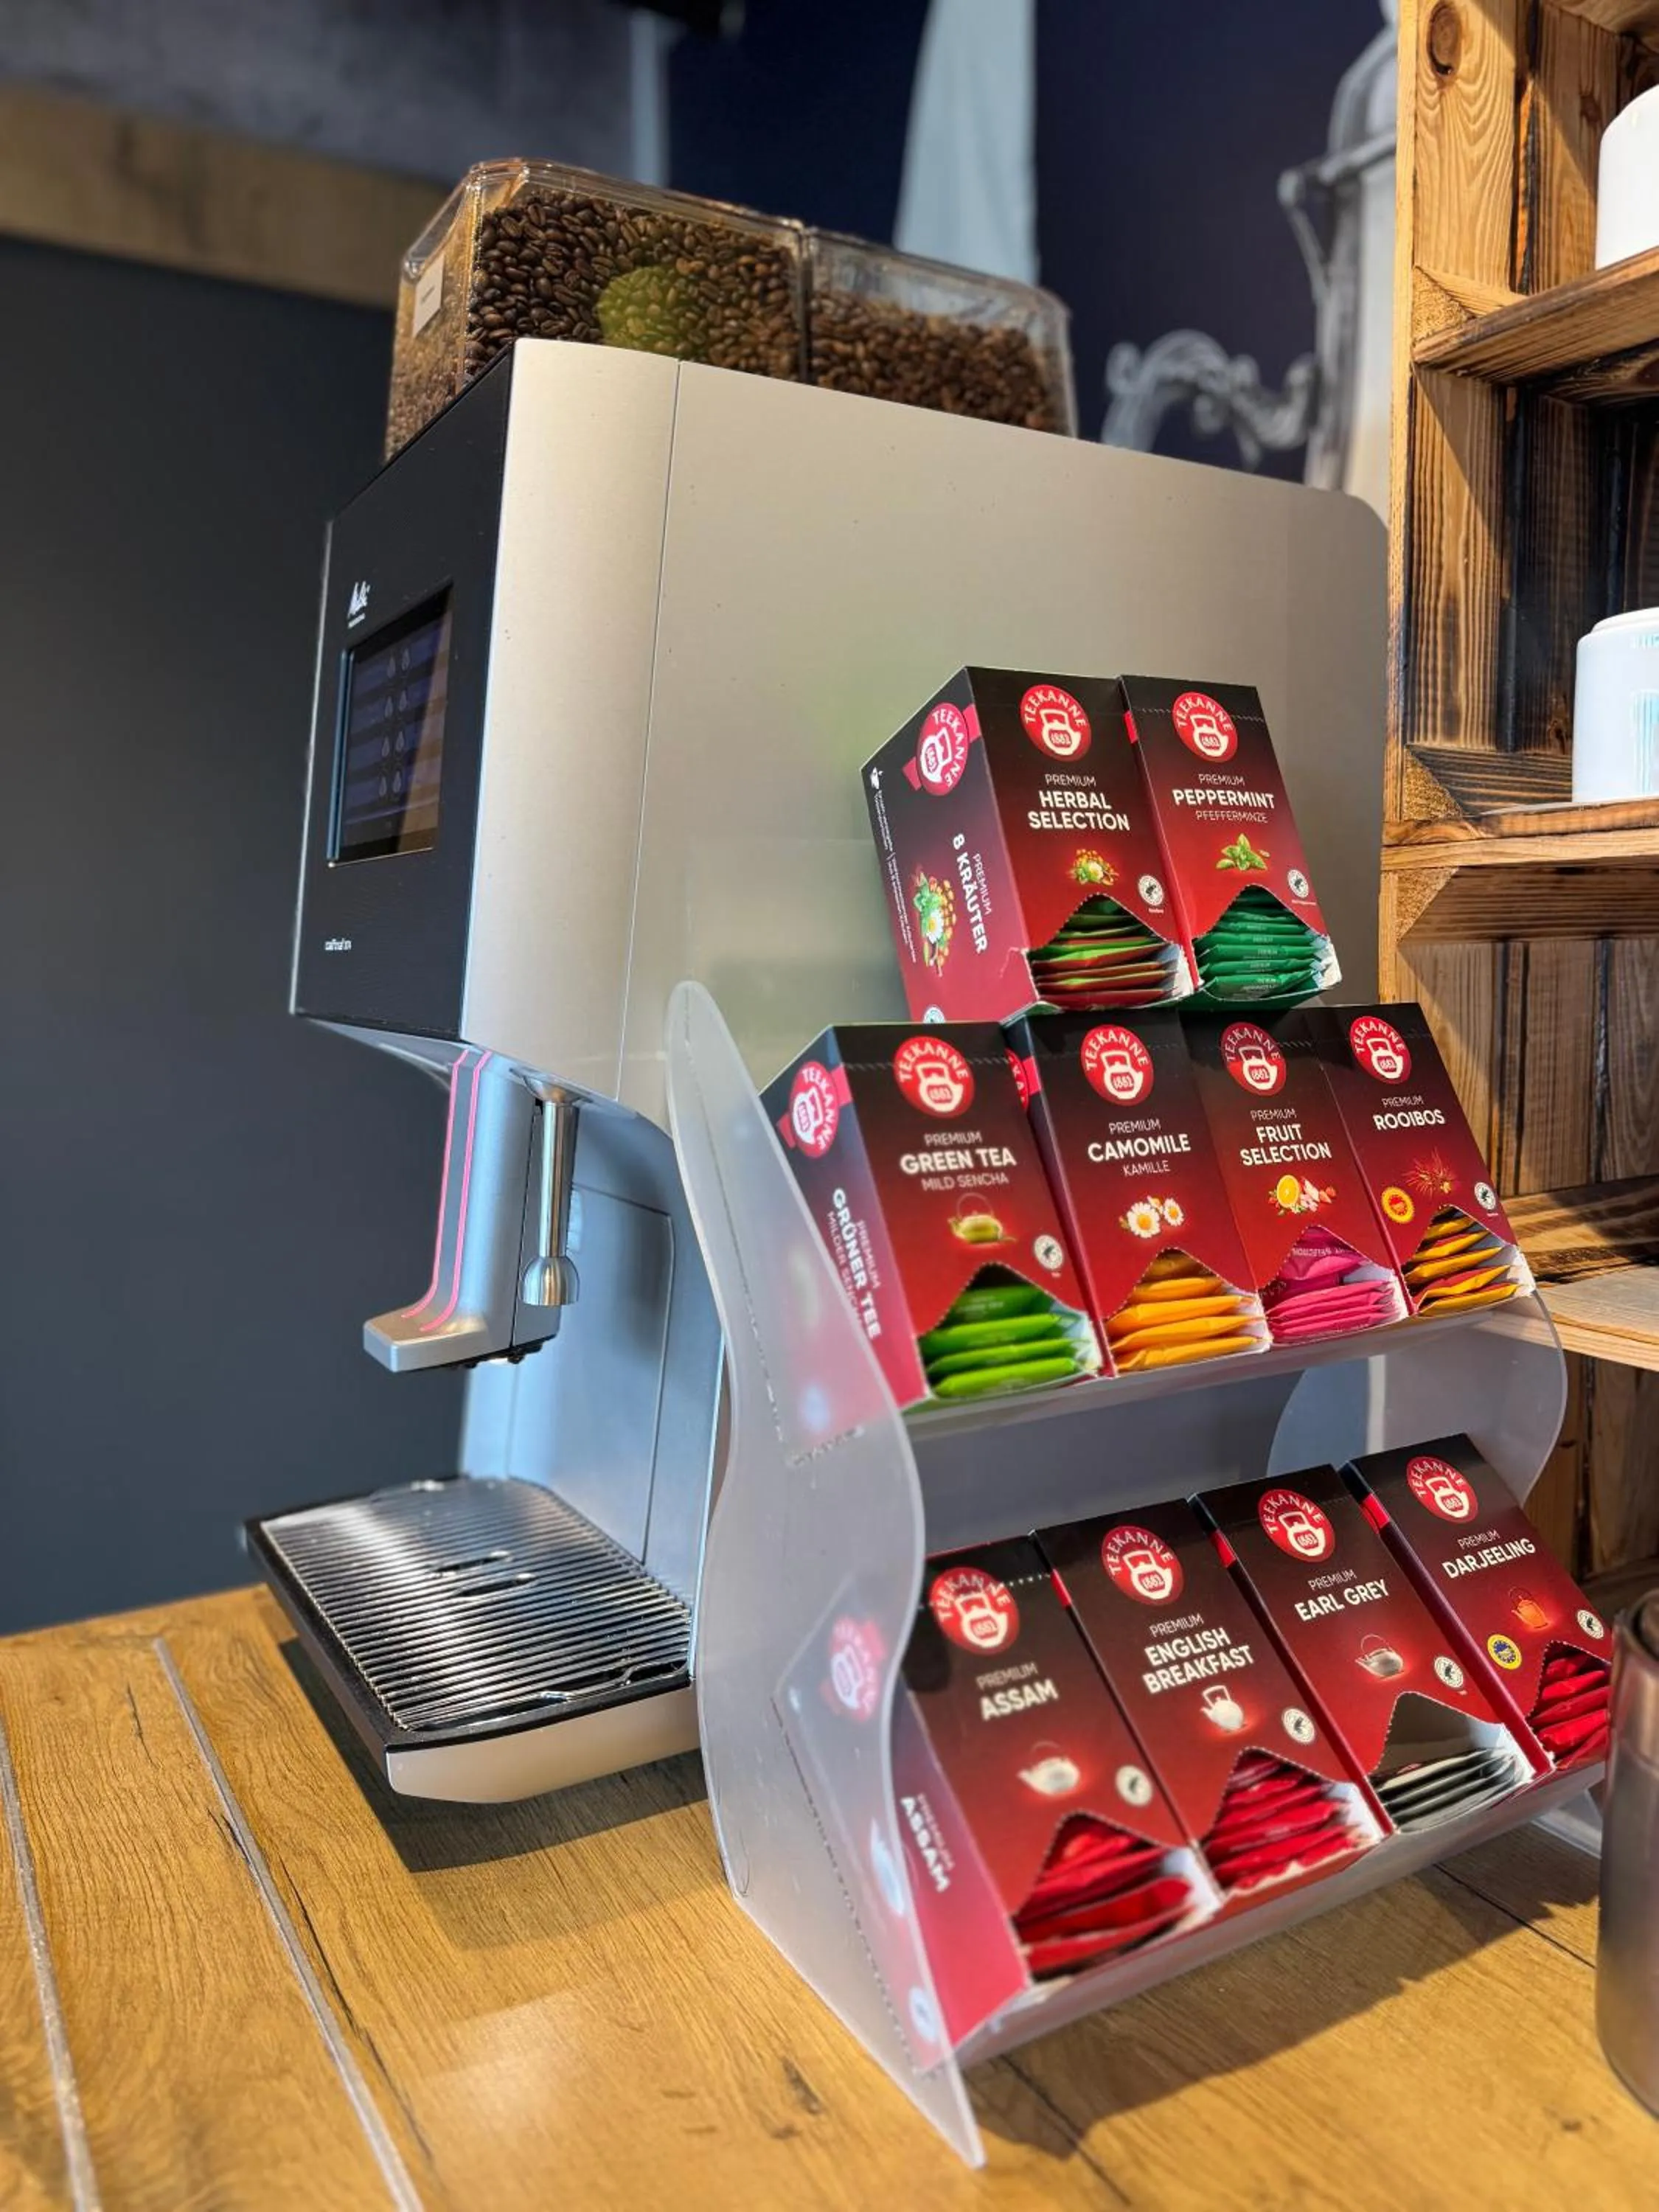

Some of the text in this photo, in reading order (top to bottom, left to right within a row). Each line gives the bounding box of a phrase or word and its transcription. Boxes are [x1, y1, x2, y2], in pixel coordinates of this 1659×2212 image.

[1024, 692, 1086, 728] TEEKANNE
[1177, 699, 1234, 731] TEEKANNE
[932, 709, 964, 787] TEEKANNE
[1045, 773, 1096, 787] PREMIUM
[1198, 774, 1245, 787] PREMIUM
[1038, 790, 1112, 810] HERBAL
[1172, 789, 1275, 810] PEPPERMINT
[1028, 811, 1130, 831] SELECTION
[1195, 810, 1269, 824] PFEFFERMINZE
[953, 834, 989, 954] 8 KRÄUTER
[972, 853, 993, 915] PREMIUM
[1084, 1029, 1149, 1071] TEEKANNE
[1225, 1027, 1281, 1062] TEEKANNE
[1354, 1021, 1405, 1054] TEEKANNE
[899, 1042, 969, 1082] TEEKANNE
[802, 1067, 835, 1150] TEEKANNE
[1251, 1108, 1297, 1121] PREMIUM
[1382, 1095, 1424, 1107] PREMIUM
[1109, 1118, 1161, 1133] PREMIUM
[1256, 1124, 1302, 1143] FRUIT
[1374, 1110, 1446, 1130] ROOIBOS
[924, 1131, 983, 1147] PREMIUM
[1088, 1133, 1191, 1163] CAMOMILE
[1240, 1142, 1332, 1166] SELECTION
[900, 1147, 1018, 1175] GREEN TEA
[1123, 1161, 1170, 1176] KAMILLE
[922, 1172, 1009, 1192] MILD SENCHA
[833, 1188, 882, 1340] GRÜNER TEE
[856, 1220, 881, 1289] PREMIUM
[1411, 1461, 1464, 1498] TEEKANNE
[1265, 1492, 1324, 1534] TEEKANNE
[1108, 1531, 1173, 1576] TEEKANNE
[1458, 1529, 1500, 1549] PREMIUM
[1441, 1537, 1536, 1579] DARJEELING
[1308, 1569, 1357, 1590] PREMIUM
[937, 1574, 1011, 1622] TEEKANNE
[1294, 1579, 1389, 1621] EARL GREY
[1150, 1613, 1204, 1638] PREMIUM
[1144, 1627, 1231, 1666] ENGLISH
[976, 1662, 1038, 1690] PREMIUM
[1142, 1645, 1253, 1694] BREAKFAST
[980, 1680, 1059, 1720] ASSAM
[900, 1797, 950, 1892] ASSAM
